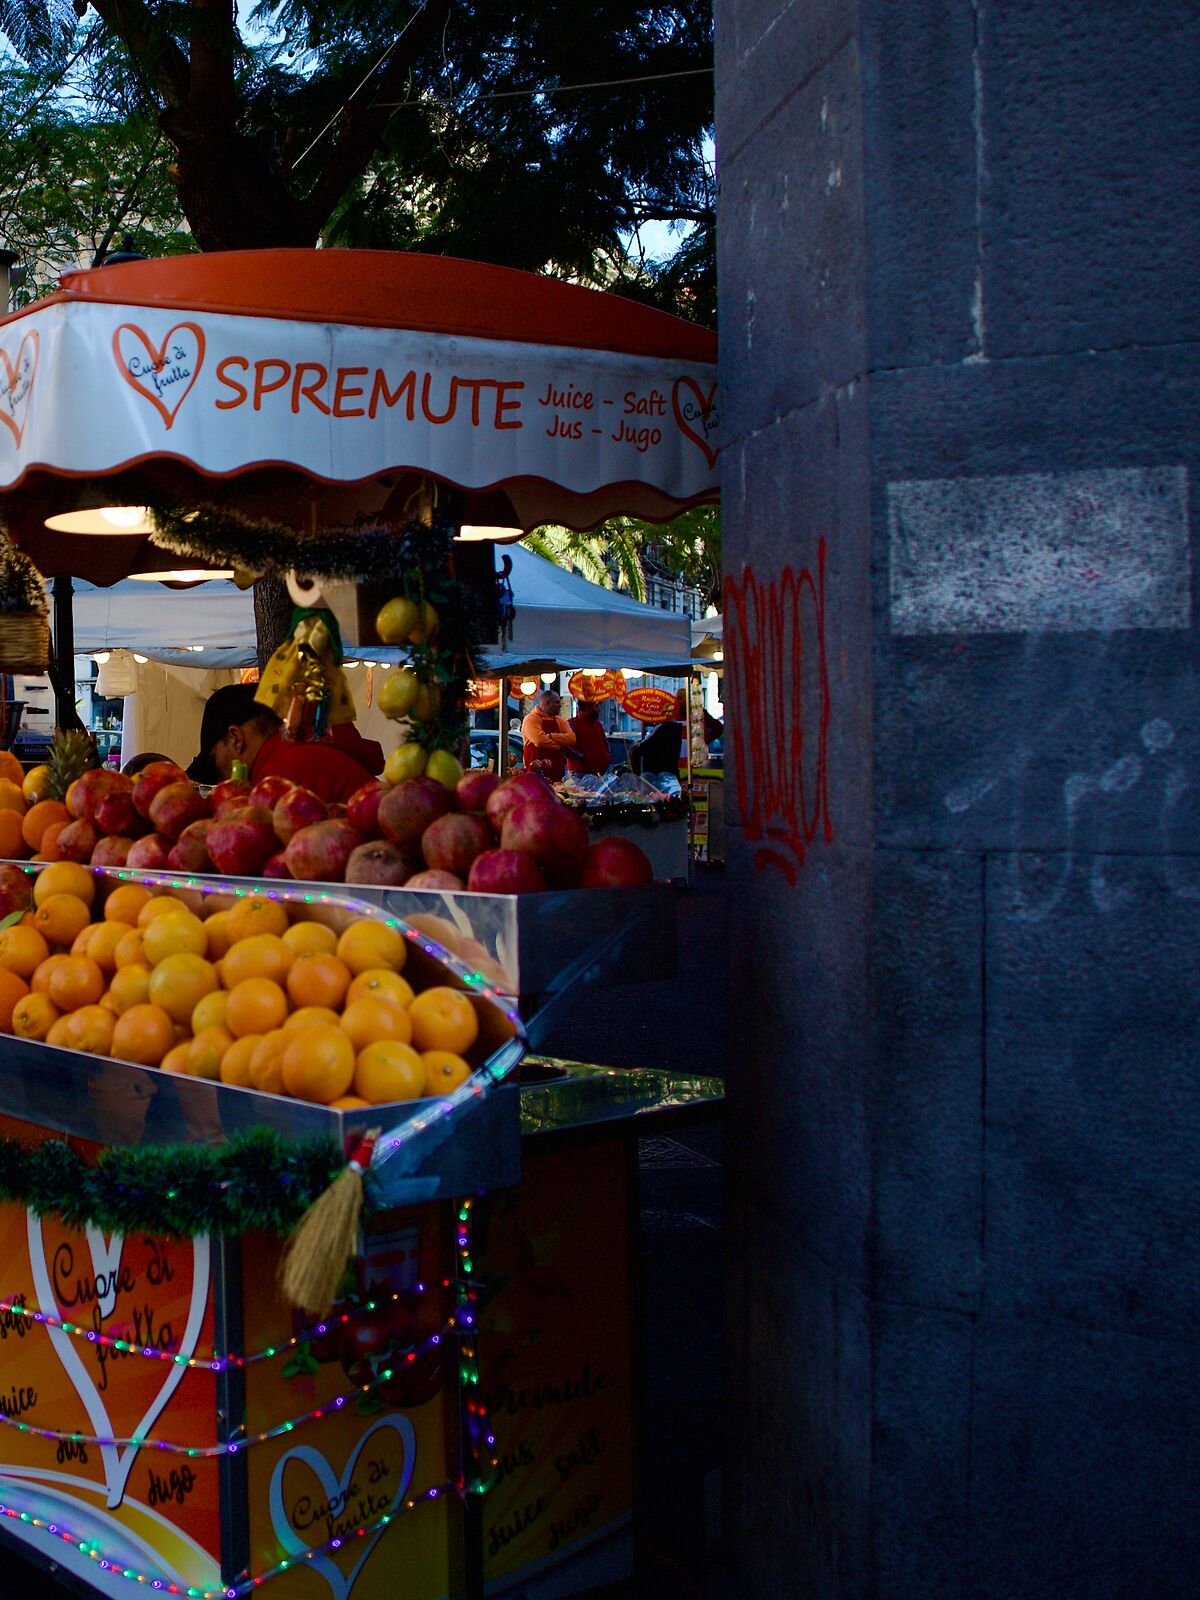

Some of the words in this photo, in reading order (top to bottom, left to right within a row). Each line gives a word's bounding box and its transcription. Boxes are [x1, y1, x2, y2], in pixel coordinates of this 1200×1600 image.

[173, 346, 187, 360] di
[152, 366, 191, 398] frutta
[215, 356, 527, 430] SPREMUTE
[538, 383, 594, 410] Juice
[623, 389, 668, 416] Saft
[546, 415, 583, 440] Jus
[612, 420, 662, 452] Jugo
[53, 1243, 136, 1307] Cuore
[144, 1238, 175, 1285] di
[292, 1484, 361, 1530] Cuore
[367, 1459, 391, 1484] di
